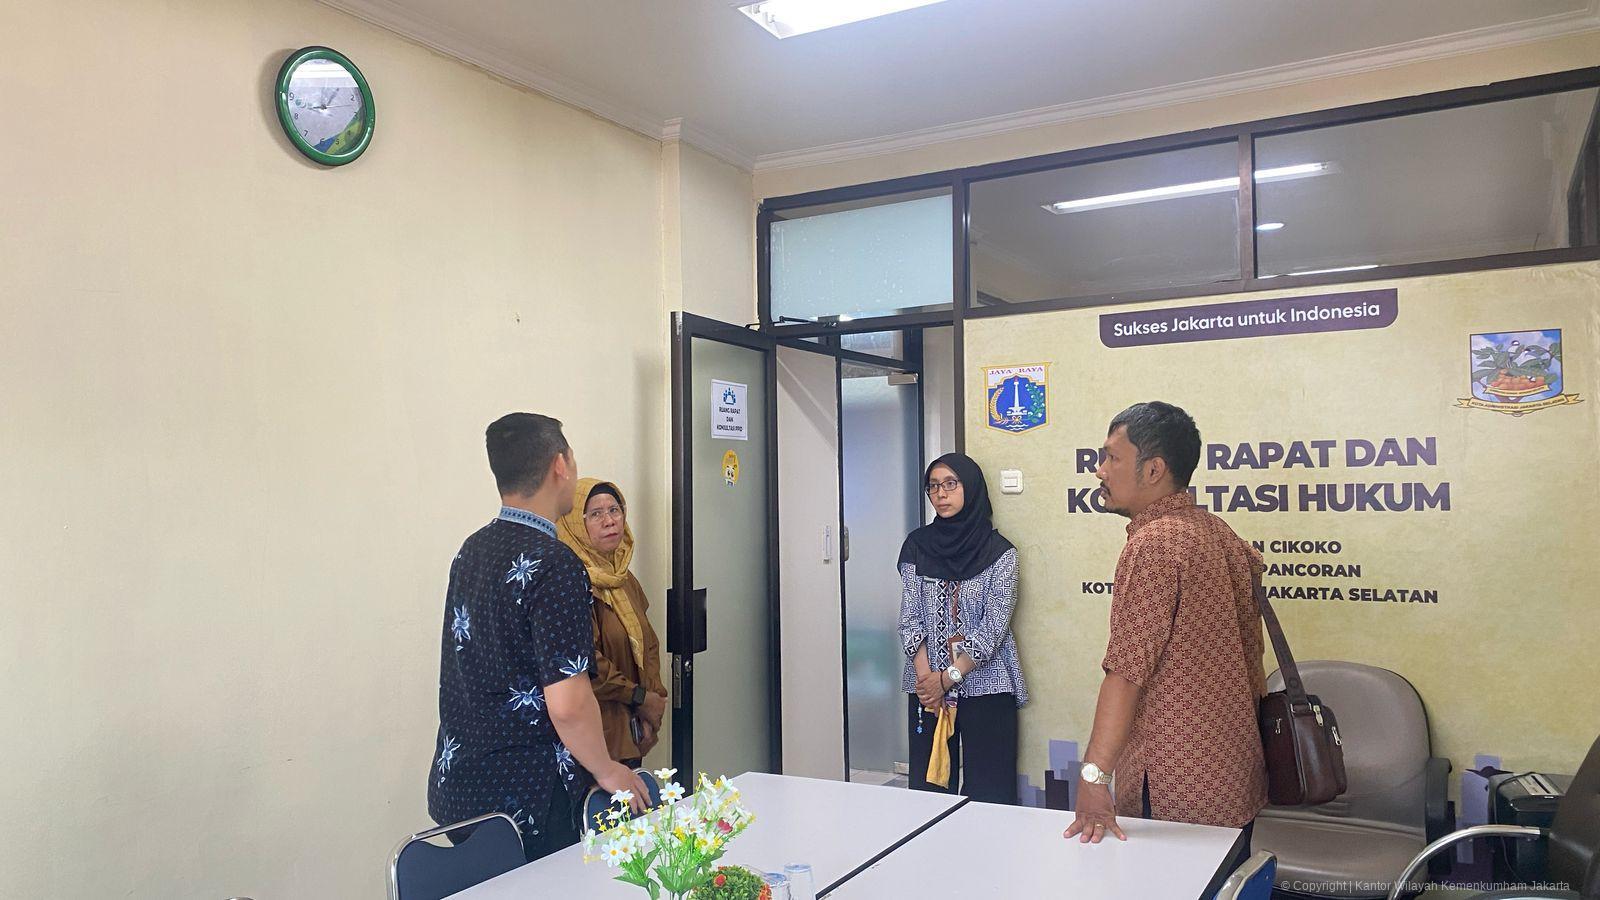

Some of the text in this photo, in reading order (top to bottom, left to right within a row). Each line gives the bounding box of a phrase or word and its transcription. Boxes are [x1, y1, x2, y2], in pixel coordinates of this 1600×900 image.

[1113, 303, 1380, 337] Sukses Jakarta untuk Indonesia
[1207, 436, 1437, 470] RAPAT DAN
[1298, 482, 1451, 512] HUKUM
[1270, 540, 1342, 554] CIKOKO
[1349, 588, 1438, 604] SELATAN
